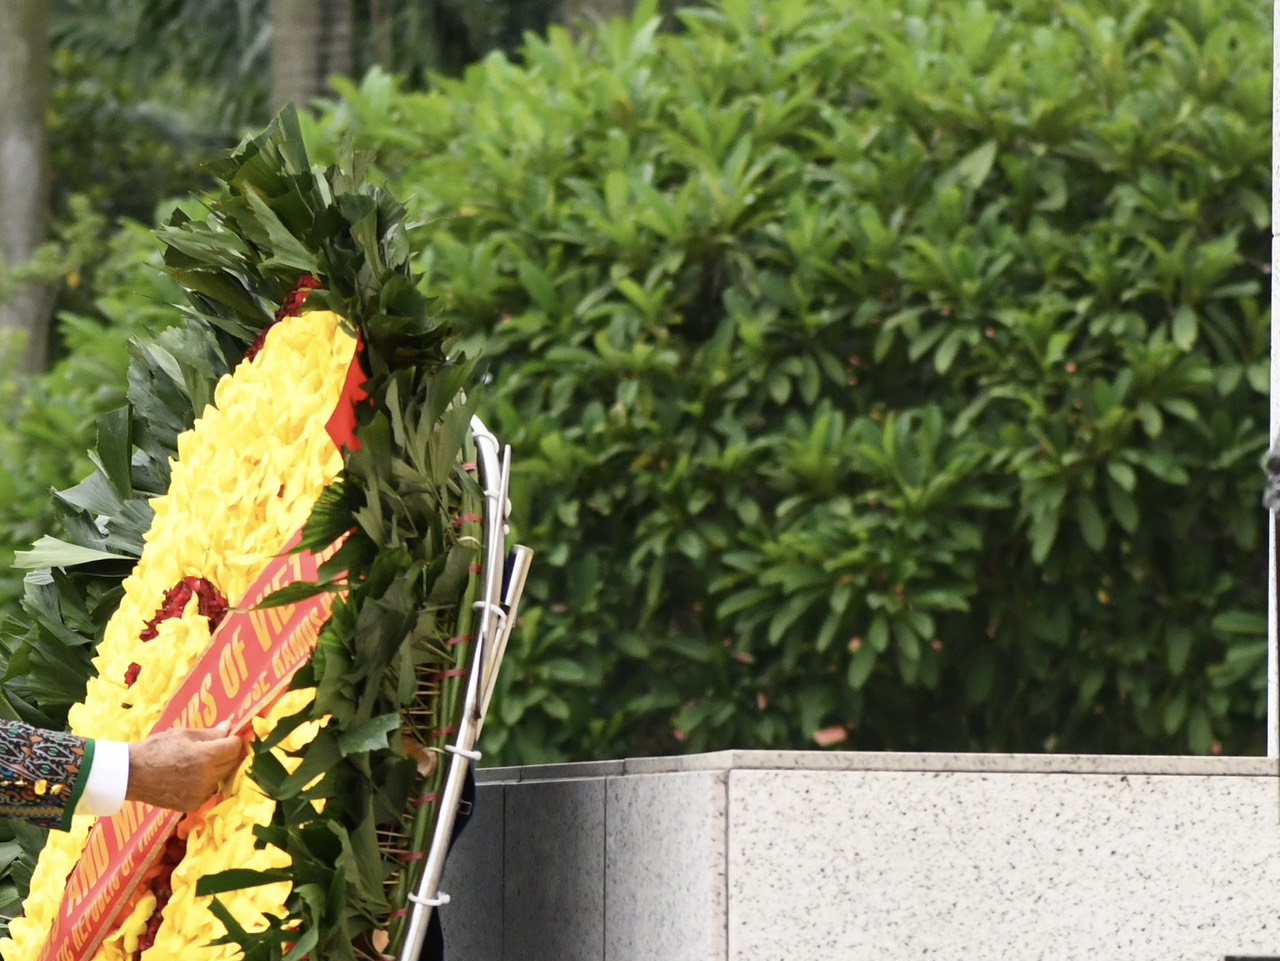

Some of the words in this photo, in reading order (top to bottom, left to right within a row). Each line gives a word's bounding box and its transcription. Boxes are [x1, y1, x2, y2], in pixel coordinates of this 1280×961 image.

[66, 822, 110, 918] AND
[219, 624, 250, 699] OF
[247, 554, 302, 652] VIET
[121, 848, 135, 877] OF
